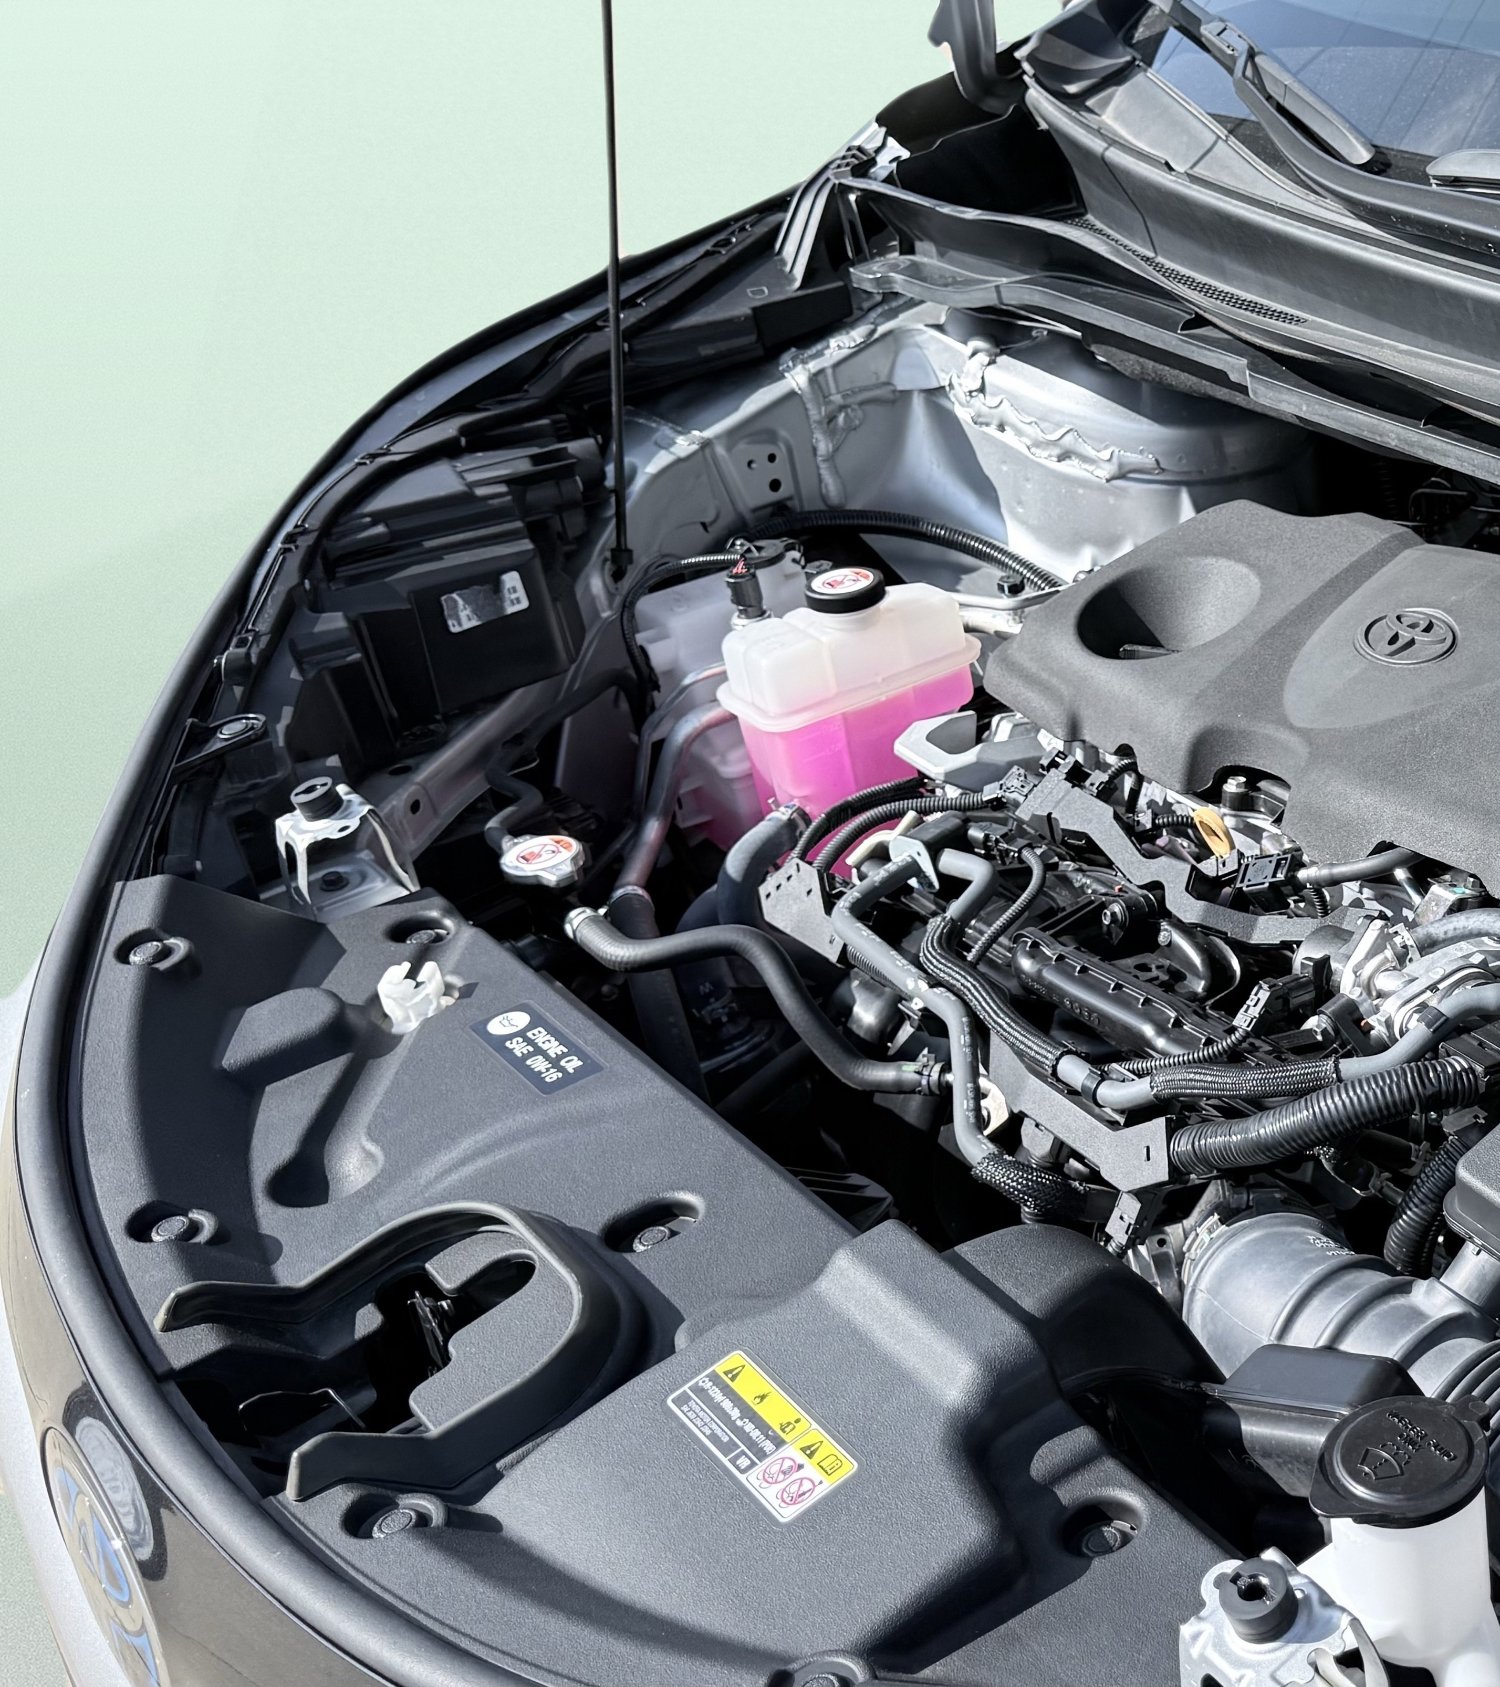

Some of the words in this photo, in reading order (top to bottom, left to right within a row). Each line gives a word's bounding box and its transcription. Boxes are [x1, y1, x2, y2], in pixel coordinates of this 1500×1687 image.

[505, 1037, 534, 1057] SAE
[526, 1055, 562, 1083] 0W-16
[526, 1027, 568, 1058] ENGINE
[560, 1056, 583, 1073] OIL
[735, 1455, 751, 1469] VR
